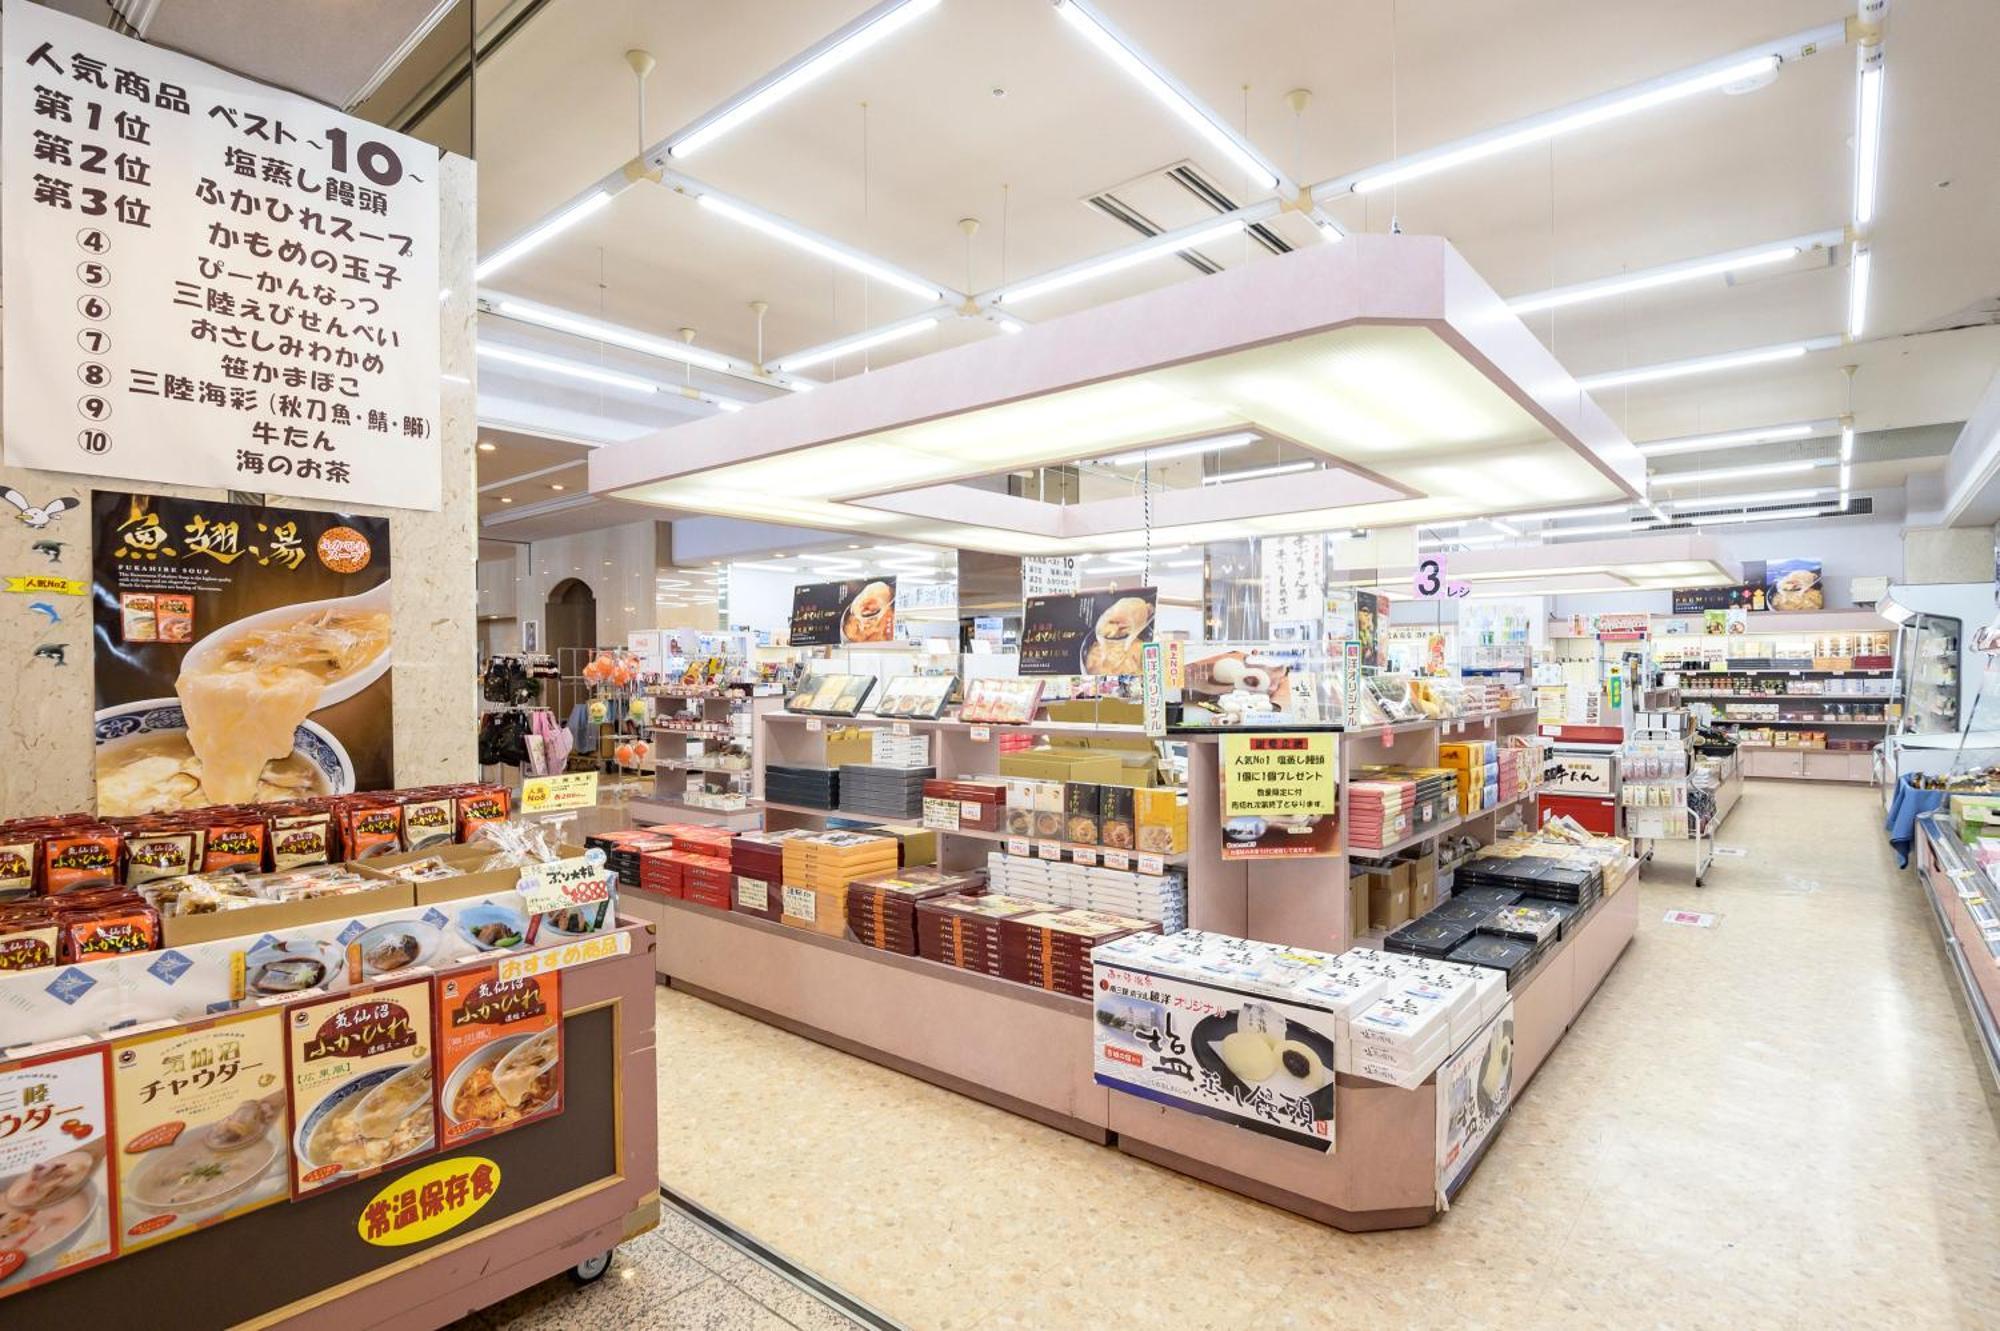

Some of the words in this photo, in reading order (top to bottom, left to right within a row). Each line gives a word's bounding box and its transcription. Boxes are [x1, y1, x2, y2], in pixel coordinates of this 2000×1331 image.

[26, 42, 190, 115] 人気商品
[33, 85, 151, 146] 第1位
[225, 147, 388, 216] 塩蒸し饅頭
[33, 130, 151, 187] 第2位
[196, 178, 413, 258] ふかひれスープ
[33, 174, 151, 229] 第3位
[209, 221, 402, 290] かもめの玉子
[173, 280, 400, 348] 三陸えびせんべい
[198, 256, 379, 315] ぴーかんなっつ
[191, 319, 384, 375] おさしみわかめ
[221, 354, 361, 398] 笹かまぼこ
[252, 421, 336, 452] 牛たん
[237, 449, 351, 484] 海のお茶
[1418, 560, 1440, 596] 3
[1174, 995, 1227, 1019] オリジナル
[139, 1062, 264, 1104] チャウダー
[365, 1164, 493, 1240] 常温保存食
